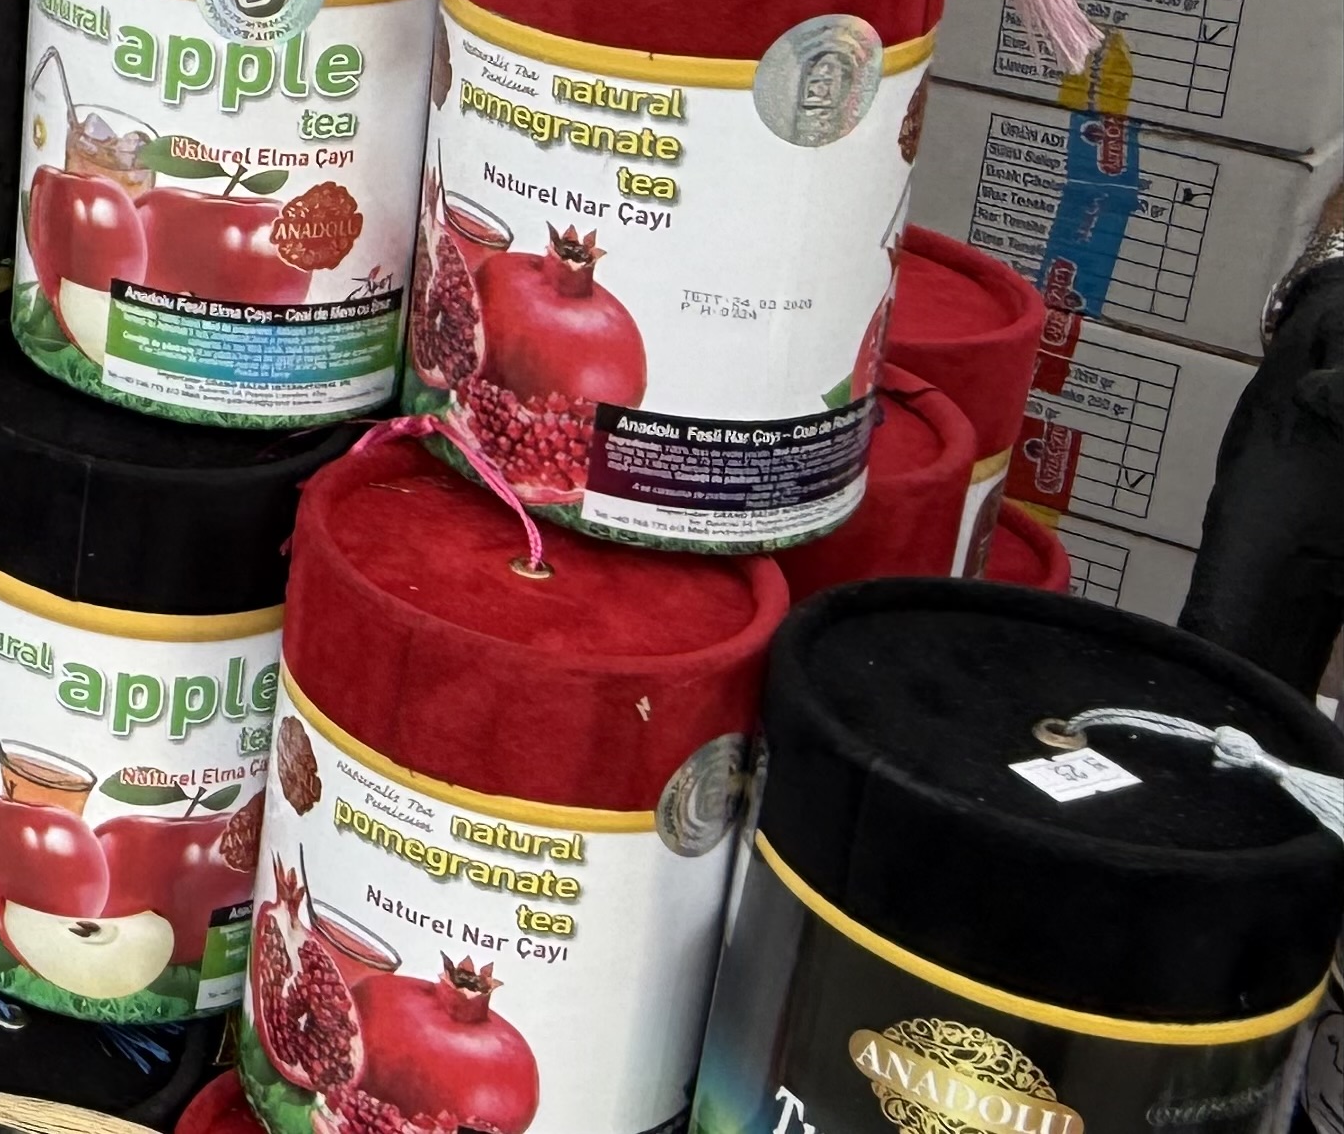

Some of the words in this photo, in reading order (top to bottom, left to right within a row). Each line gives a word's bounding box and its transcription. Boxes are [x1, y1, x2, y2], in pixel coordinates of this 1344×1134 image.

[113, 22, 364, 113] apple
[461, 78, 682, 160] pomegranate
[552, 74, 683, 119] natural
[298, 108, 359, 140] tea
[257, 147, 309, 166] Elma
[315, 146, 355, 170] Çayı
[484, 162, 559, 207] Naturel
[566, 191, 611, 218] Nar
[618, 203, 672, 231] Çayı
[617, 167, 676, 200] tea
[124, 285, 175, 310] Anadolu
[617, 416, 680, 439] Anadolu
[120, 766, 196, 787] Naturel
[202, 767, 246, 785] Elma
[334, 797, 580, 899] pomegranate
[450, 815, 584, 861] natural
[366, 884, 454, 939] Naturel
[462, 923, 509, 952] Nar
[516, 937, 568, 964] Çayı
[516, 904, 574, 936] tea
[856, 1040, 1073, 1134] ANADOLU
